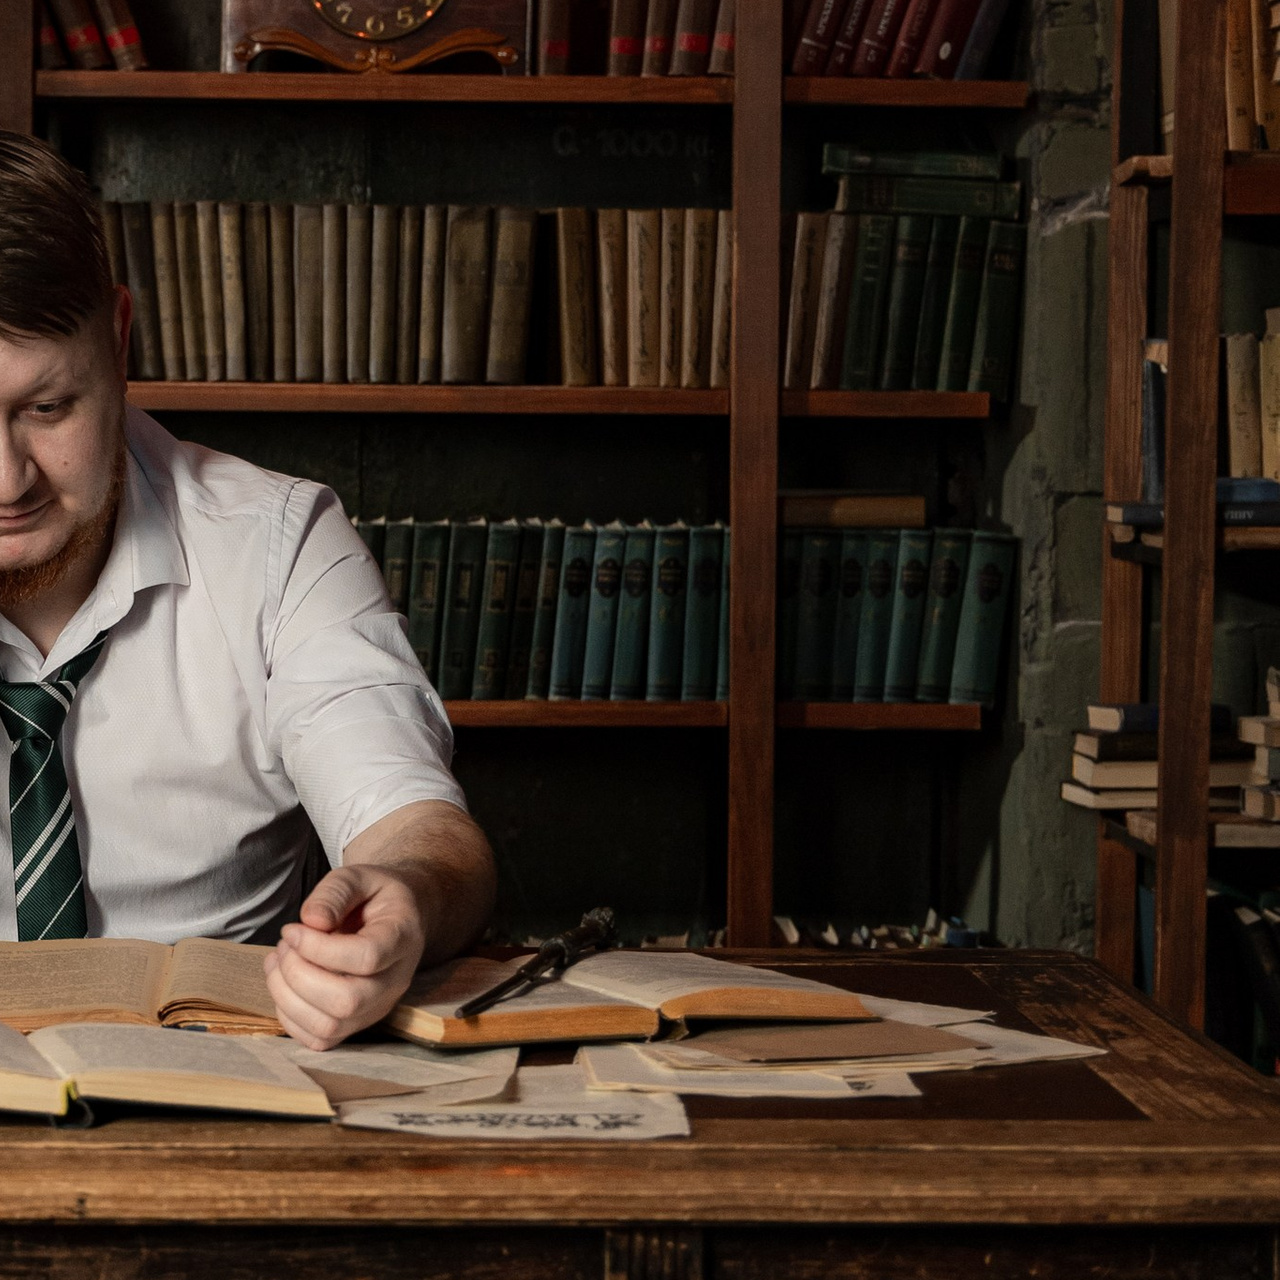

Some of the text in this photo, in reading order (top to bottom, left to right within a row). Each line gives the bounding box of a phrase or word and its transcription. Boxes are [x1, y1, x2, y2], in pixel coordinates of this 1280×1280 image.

[336, 2, 353, 23] 7
[396, 6, 415, 27] 5
[365, 16, 384, 34] 6
